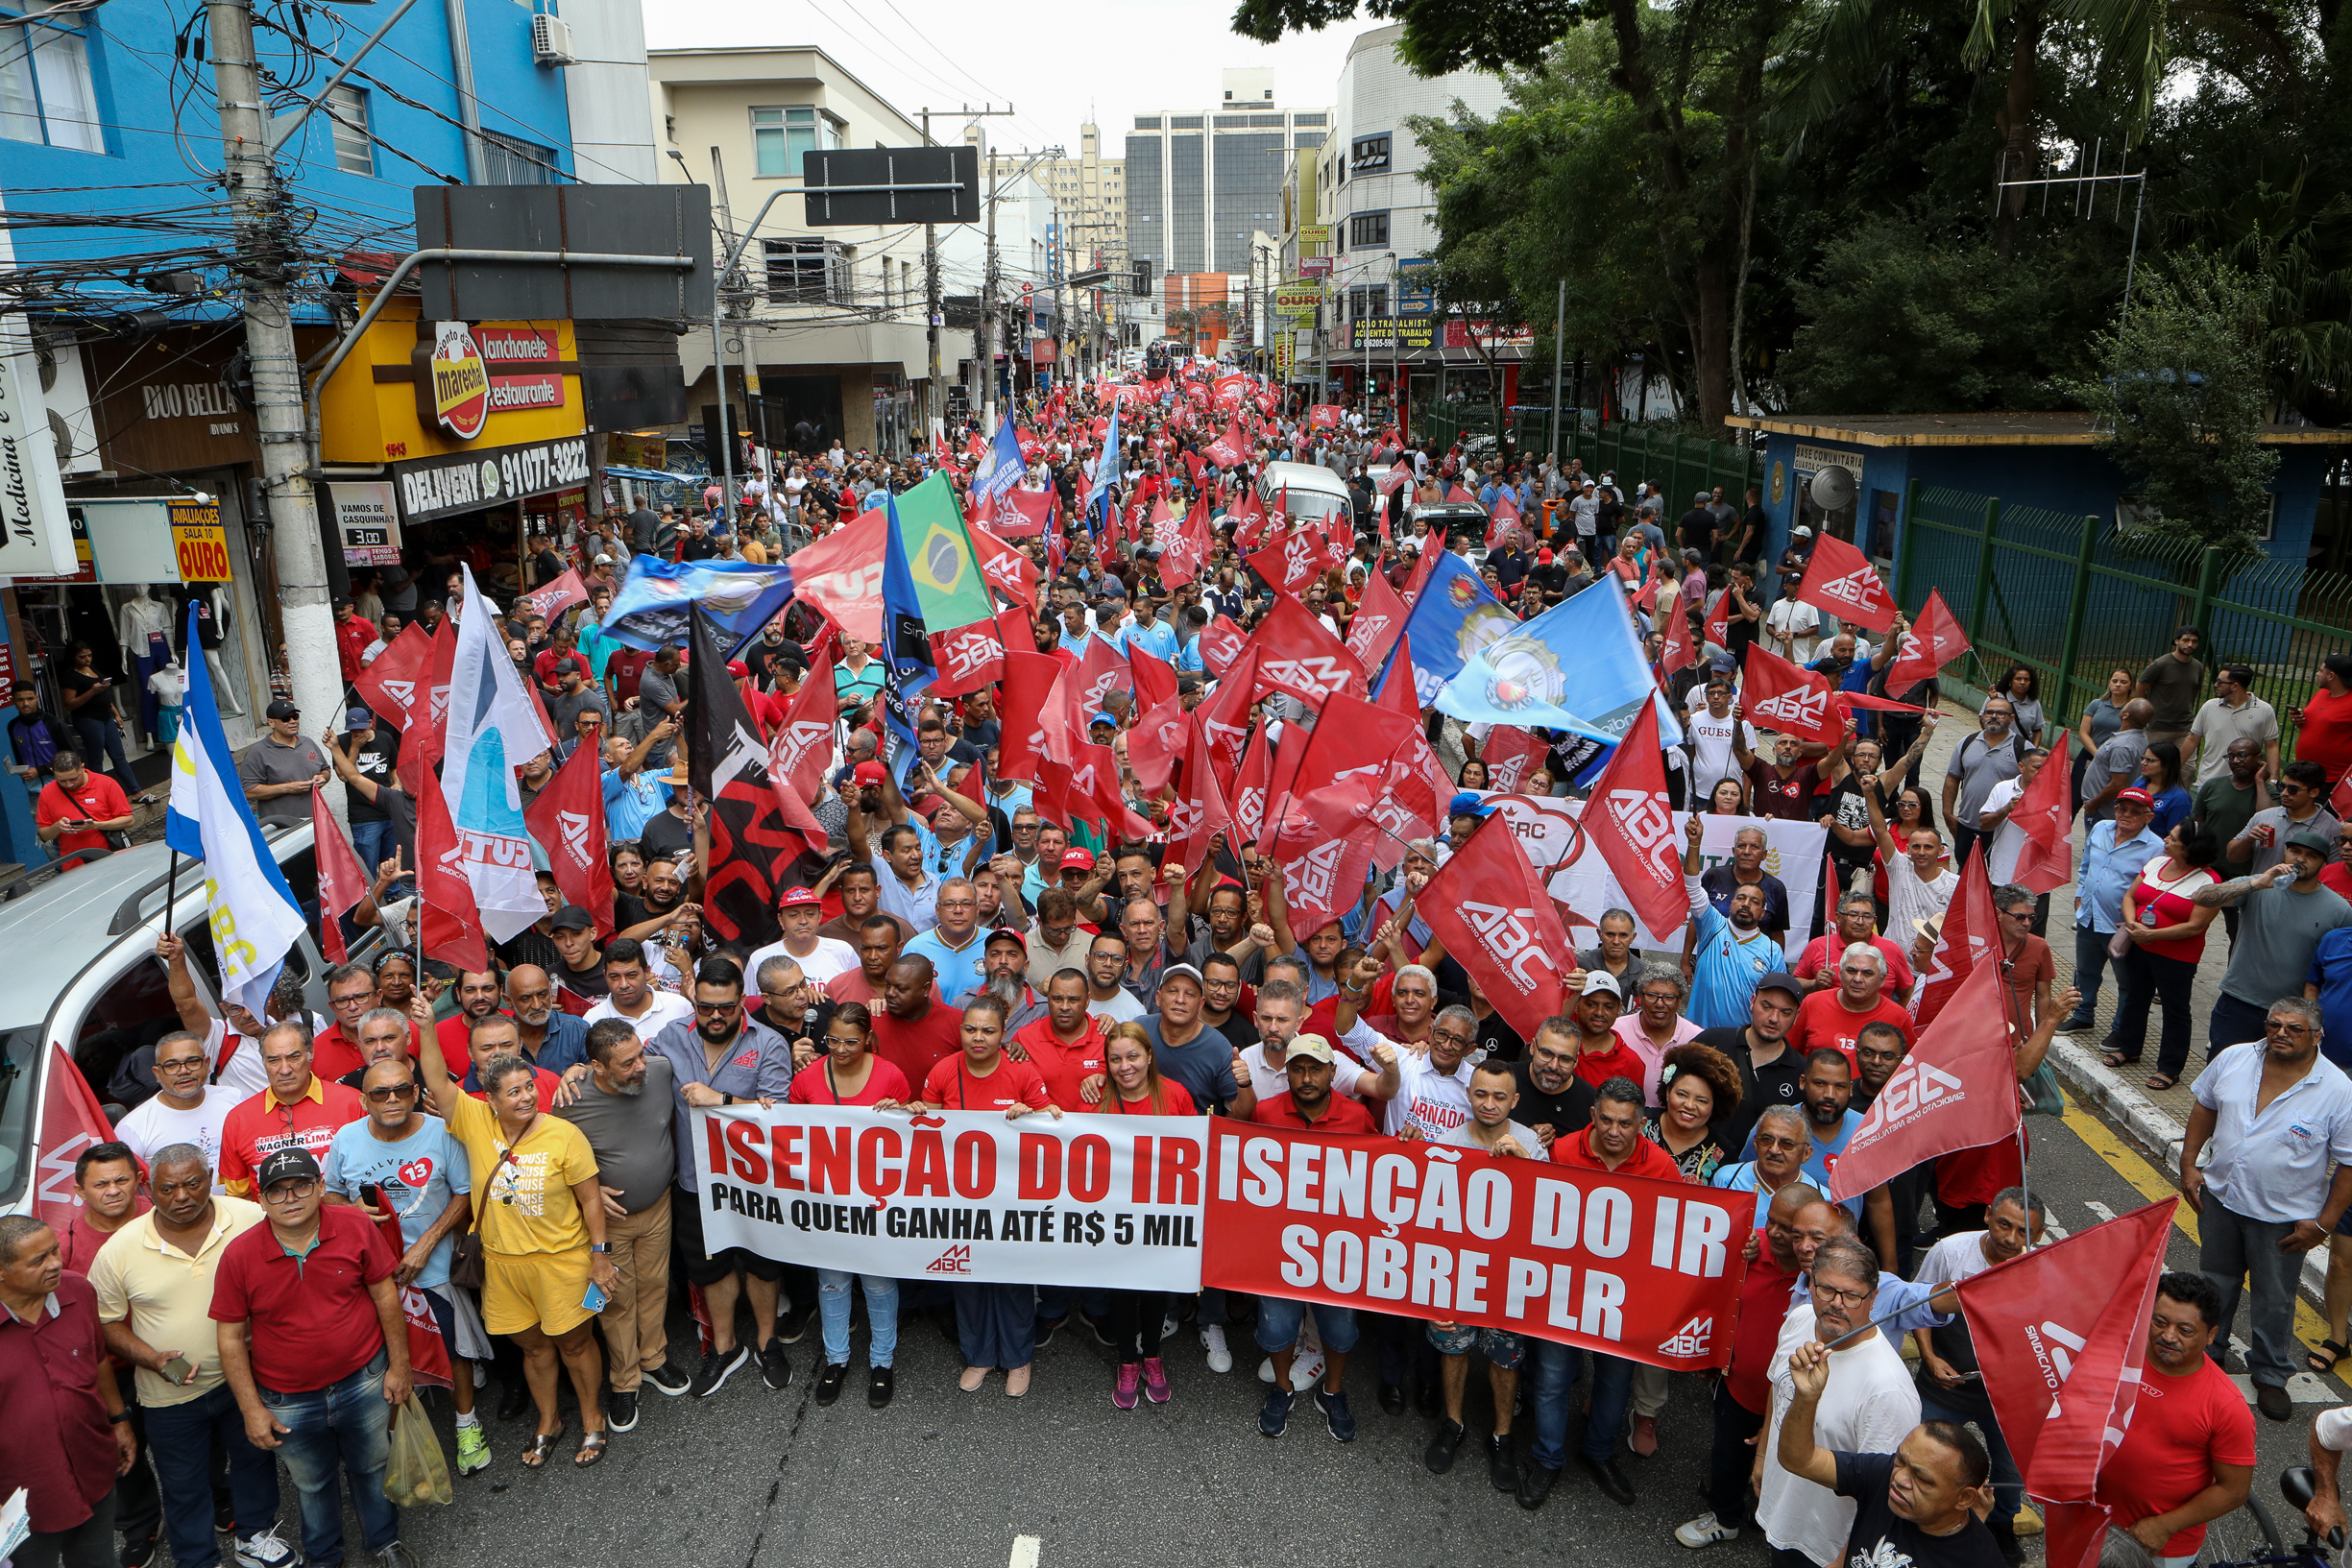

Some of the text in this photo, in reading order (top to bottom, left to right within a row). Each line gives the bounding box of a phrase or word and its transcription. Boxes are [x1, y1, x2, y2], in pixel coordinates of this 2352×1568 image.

[437, 329, 470, 356] ponto da
[482, 332, 547, 360] lanchonete
[436, 362, 484, 403] marechal
[489, 379, 555, 407] restaurante
[143, 385, 182, 420] DUO
[385, 442, 406, 456] 1513
[1796, 446, 1812, 460] BASE
[1813, 450, 1862, 469] COMUNITÁRIA
[501, 439, 590, 497] 91077-3822
[1795, 460, 1815, 470] GUARDA
[3, 435, 36, 547] Medicina
[402, 463, 480, 516] DELIVERY
[172, 505, 220, 526] AVALIAÇÕES
[343, 515, 395, 524] CASQUINHA?
[184, 528, 213, 540] SALA 10
[355, 530, 380, 545] 3,00
[180, 542, 228, 578] OURO
[1822, 577, 1881, 610] ABC
[1755, 696, 1824, 727] ABC
[359, 753, 381, 763] NIKE
[375, 763, 388, 774] SB
[1786, 786, 1798, 796] 13
[1604, 797, 1620, 827] SINDICATO
[1610, 789, 1677, 882] ABC
[1662, 869, 1672, 880] CUT
[1454, 906, 1480, 938] SINDICATO
[1462, 901, 1556, 991] ABC
[1525, 977, 1537, 989] CUT
[1838, 1037, 1855, 1049] 13
[733, 1056, 757, 1066] ABC
[1410, 1097, 1466, 1128] JORNADA
[1419, 1096, 1450, 1109] REDUZIR
[404, 1163, 428, 1181] 13
[705, 1115, 1200, 1211] ISENÇÃO DO IR
[712, 1182, 1198, 1248] PARA QUEM GANHA ATÉ R$ 5 MIL
[1219, 1134, 1730, 1278] ISENÇÃO DO IR
[926, 1258, 971, 1272] ABC
[1280, 1224, 1627, 1341] SOBRE PLR
[1658, 1335, 1710, 1354] ABC
[2025, 1325, 2059, 1388] SINDICATO
